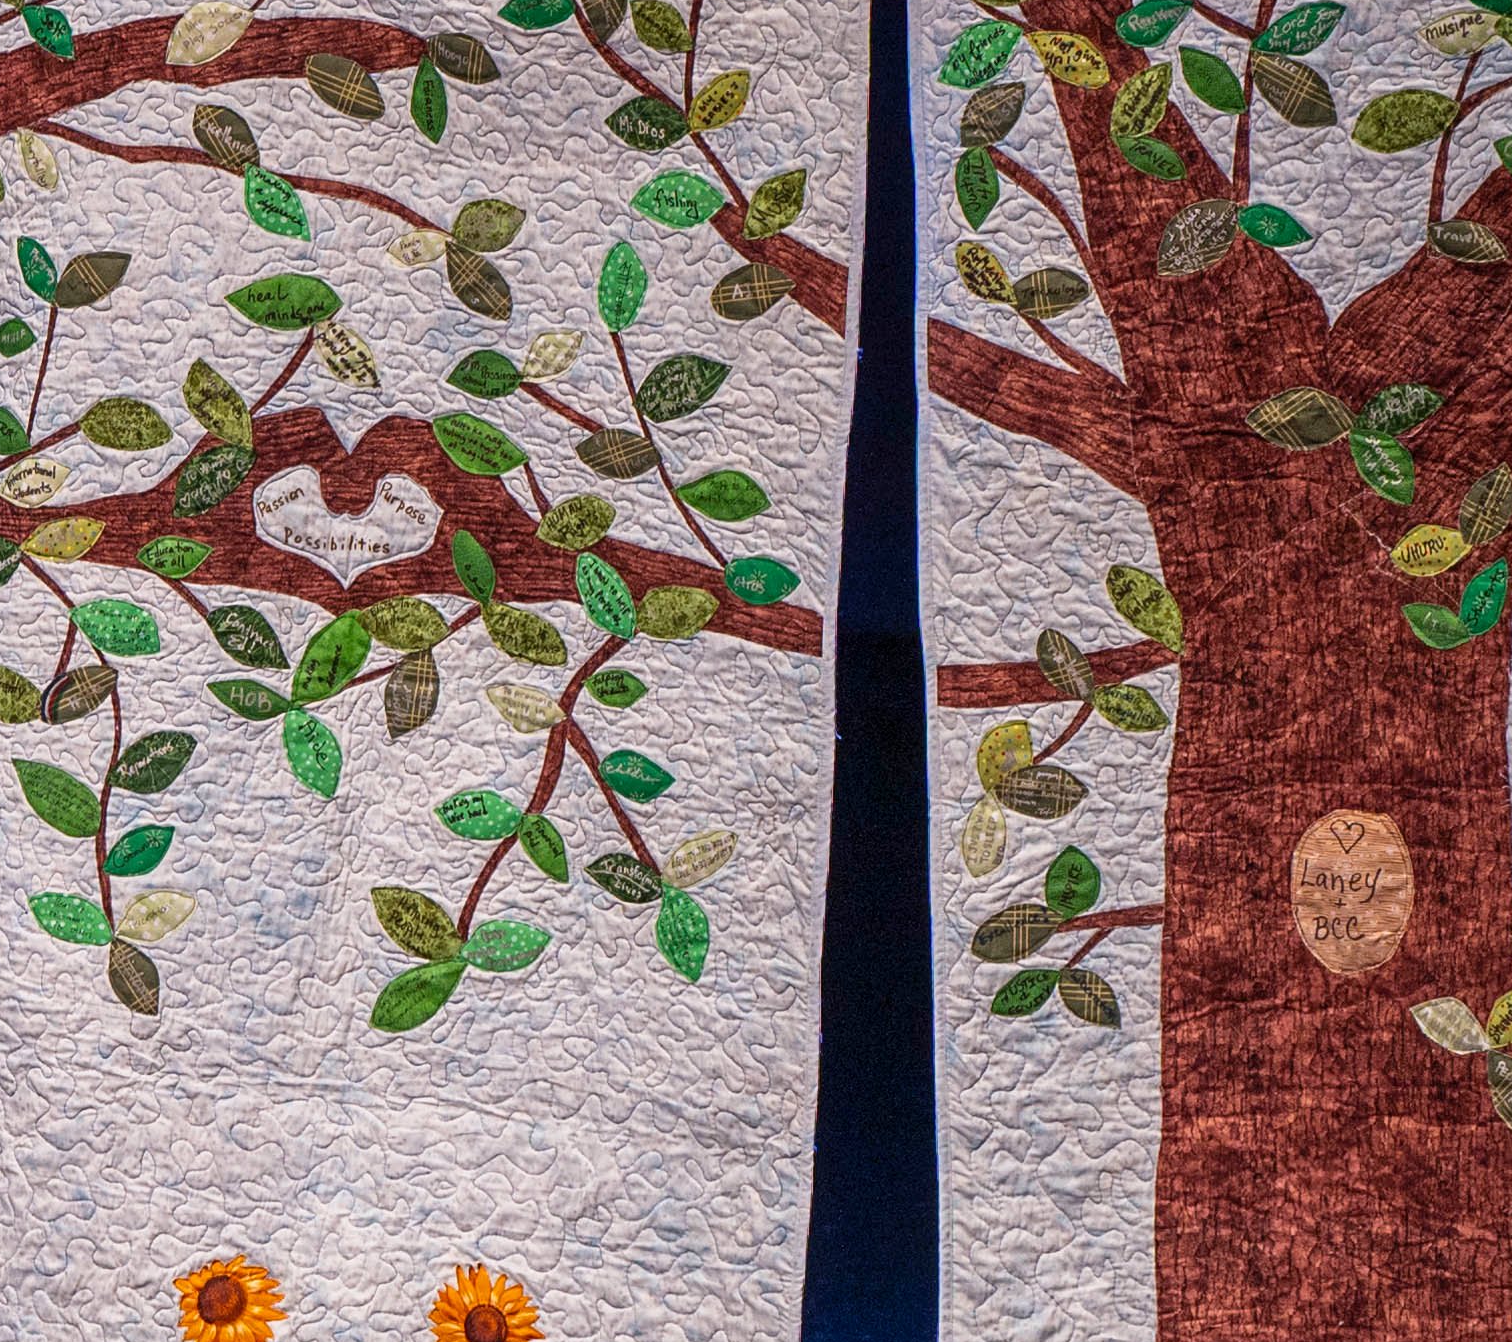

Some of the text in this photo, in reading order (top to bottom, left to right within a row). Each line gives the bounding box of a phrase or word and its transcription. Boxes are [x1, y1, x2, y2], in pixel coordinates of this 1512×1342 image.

[619, 115, 634, 132] Mi
[1130, 139, 1178, 177] TRAVEL
[654, 188, 700, 219] fishing
[12, 482, 53, 501] Students
[256, 486, 305, 518] Passion
[379, 481, 427, 525] Purpose
[146, 542, 195, 562] Education
[284, 526, 392, 554] Possibilities
[171, 555, 186, 569] all
[230, 686, 272, 713] HOB
[299, 719, 328, 771] Aide
[1300, 858, 1382, 904] Laney
[1334, 898, 1347, 909] +
[1314, 915, 1366, 942] BCC
